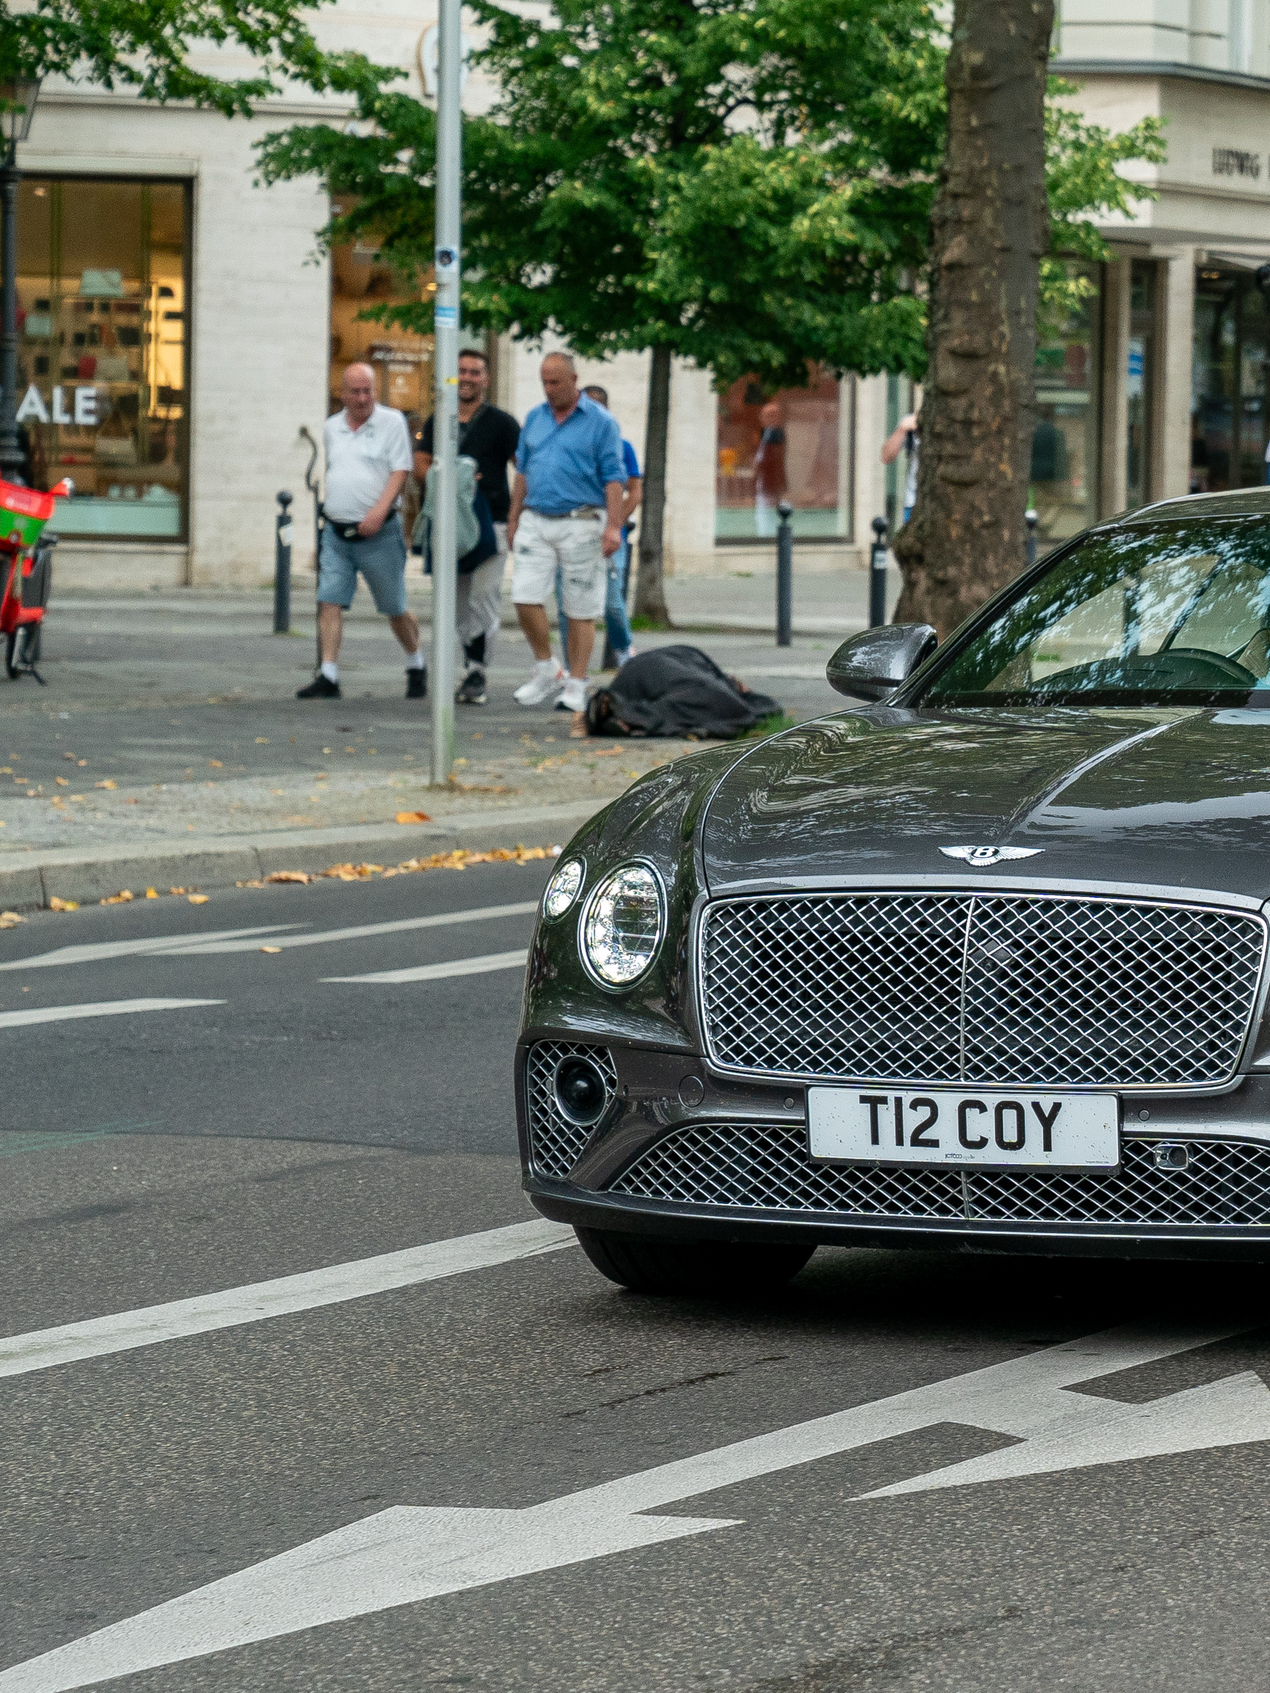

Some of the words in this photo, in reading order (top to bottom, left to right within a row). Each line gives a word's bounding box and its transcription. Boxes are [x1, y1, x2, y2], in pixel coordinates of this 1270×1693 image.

[15, 383, 98, 424] ALE
[859, 1094, 941, 1149] T12
[957, 1099, 1063, 1153] COY
